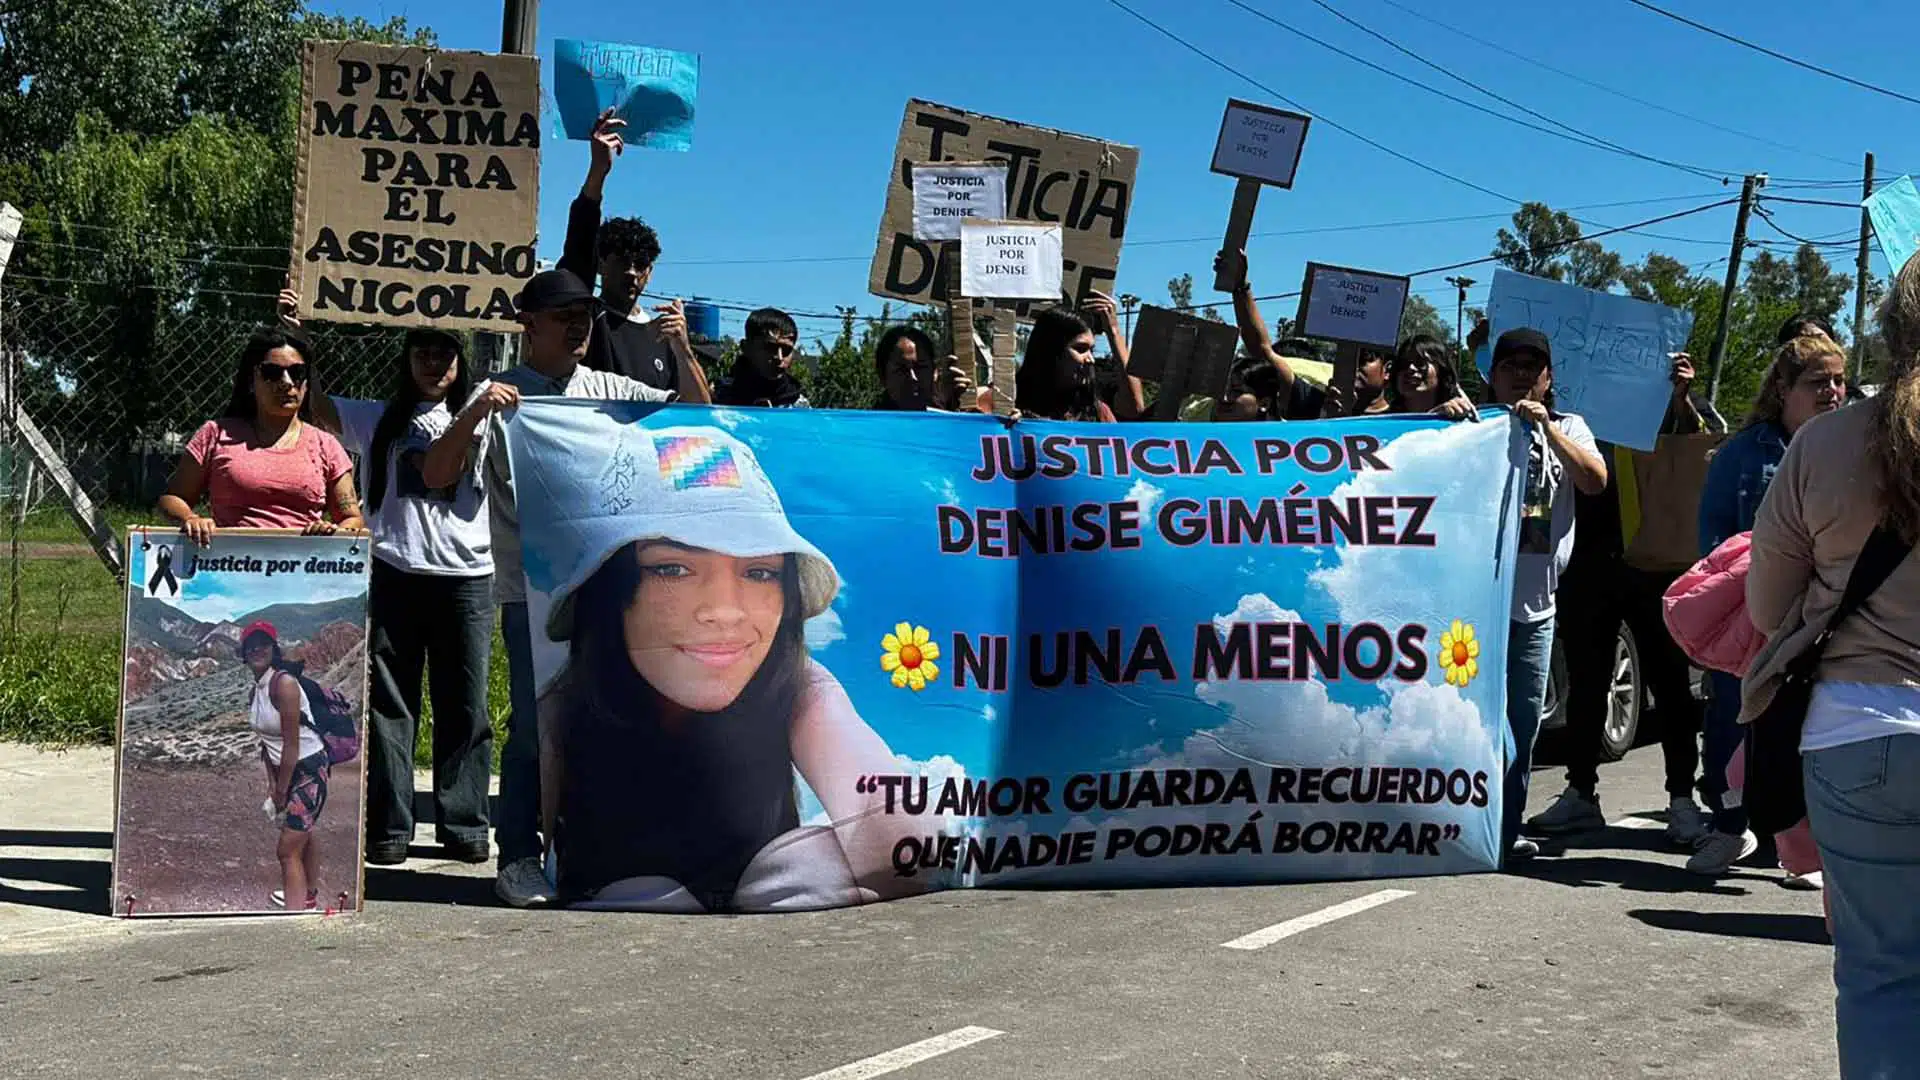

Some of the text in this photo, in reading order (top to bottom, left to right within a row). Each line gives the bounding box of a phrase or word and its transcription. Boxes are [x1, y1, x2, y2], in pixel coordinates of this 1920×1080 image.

[337, 59, 503, 108] PENA
[312, 101, 540, 148] MAXIMA
[1241, 115, 1287, 135] JUSTICIA
[361, 147, 518, 190] PARA
[933, 176, 985, 187] JUSTICIA
[384, 186, 456, 226] EL
[947, 191, 971, 201] POR
[933, 207, 974, 217] DENISE
[305, 226, 536, 279] ASESINO
[986, 235, 1037, 247] JUSTICIA
[999, 249, 1025, 260] POR
[985, 264, 1029, 276] DENISE
[313, 276, 525, 321] NICOLA
[1335, 280, 1380, 294] JUSTICIA
[1346, 294, 1367, 305] POR
[1330, 304, 1368, 320] DENISE
[971, 433, 1391, 481] JUSTICIA POR
[936, 484, 1437, 558] DENISE GIMÉNEZ
[189, 554, 365, 576] justicia por denise
[952, 622, 1429, 692] NI UNA MENOS
[856, 767, 1489, 816] “TU AMOR GUARDA RECUERDOS
[891, 809, 1461, 878] QUE NADIE PODRÁ BORRAR”
